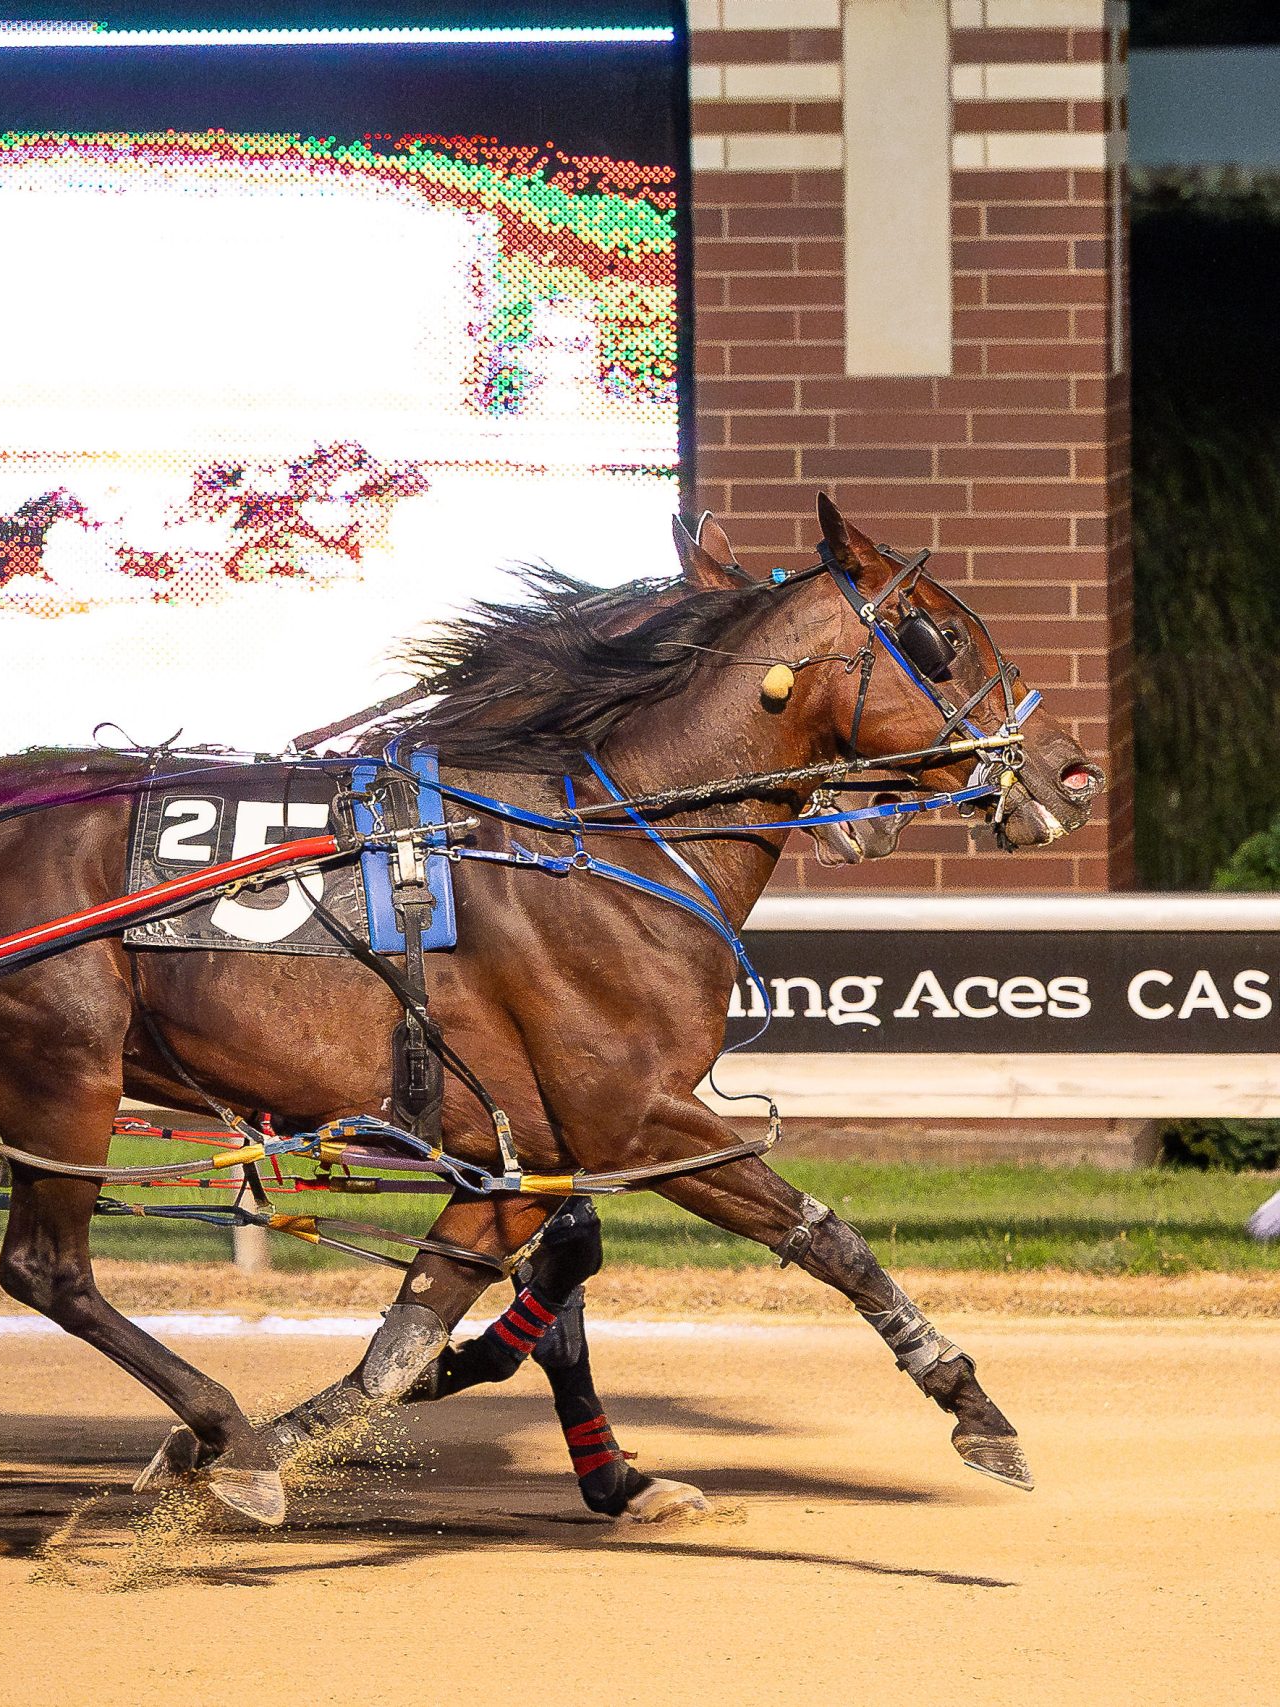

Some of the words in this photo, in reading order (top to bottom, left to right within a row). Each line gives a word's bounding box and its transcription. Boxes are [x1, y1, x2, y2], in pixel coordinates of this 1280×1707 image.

[158, 799, 218, 862] 2
[210, 800, 330, 944] 5
[893, 969, 1092, 1019] Aces
